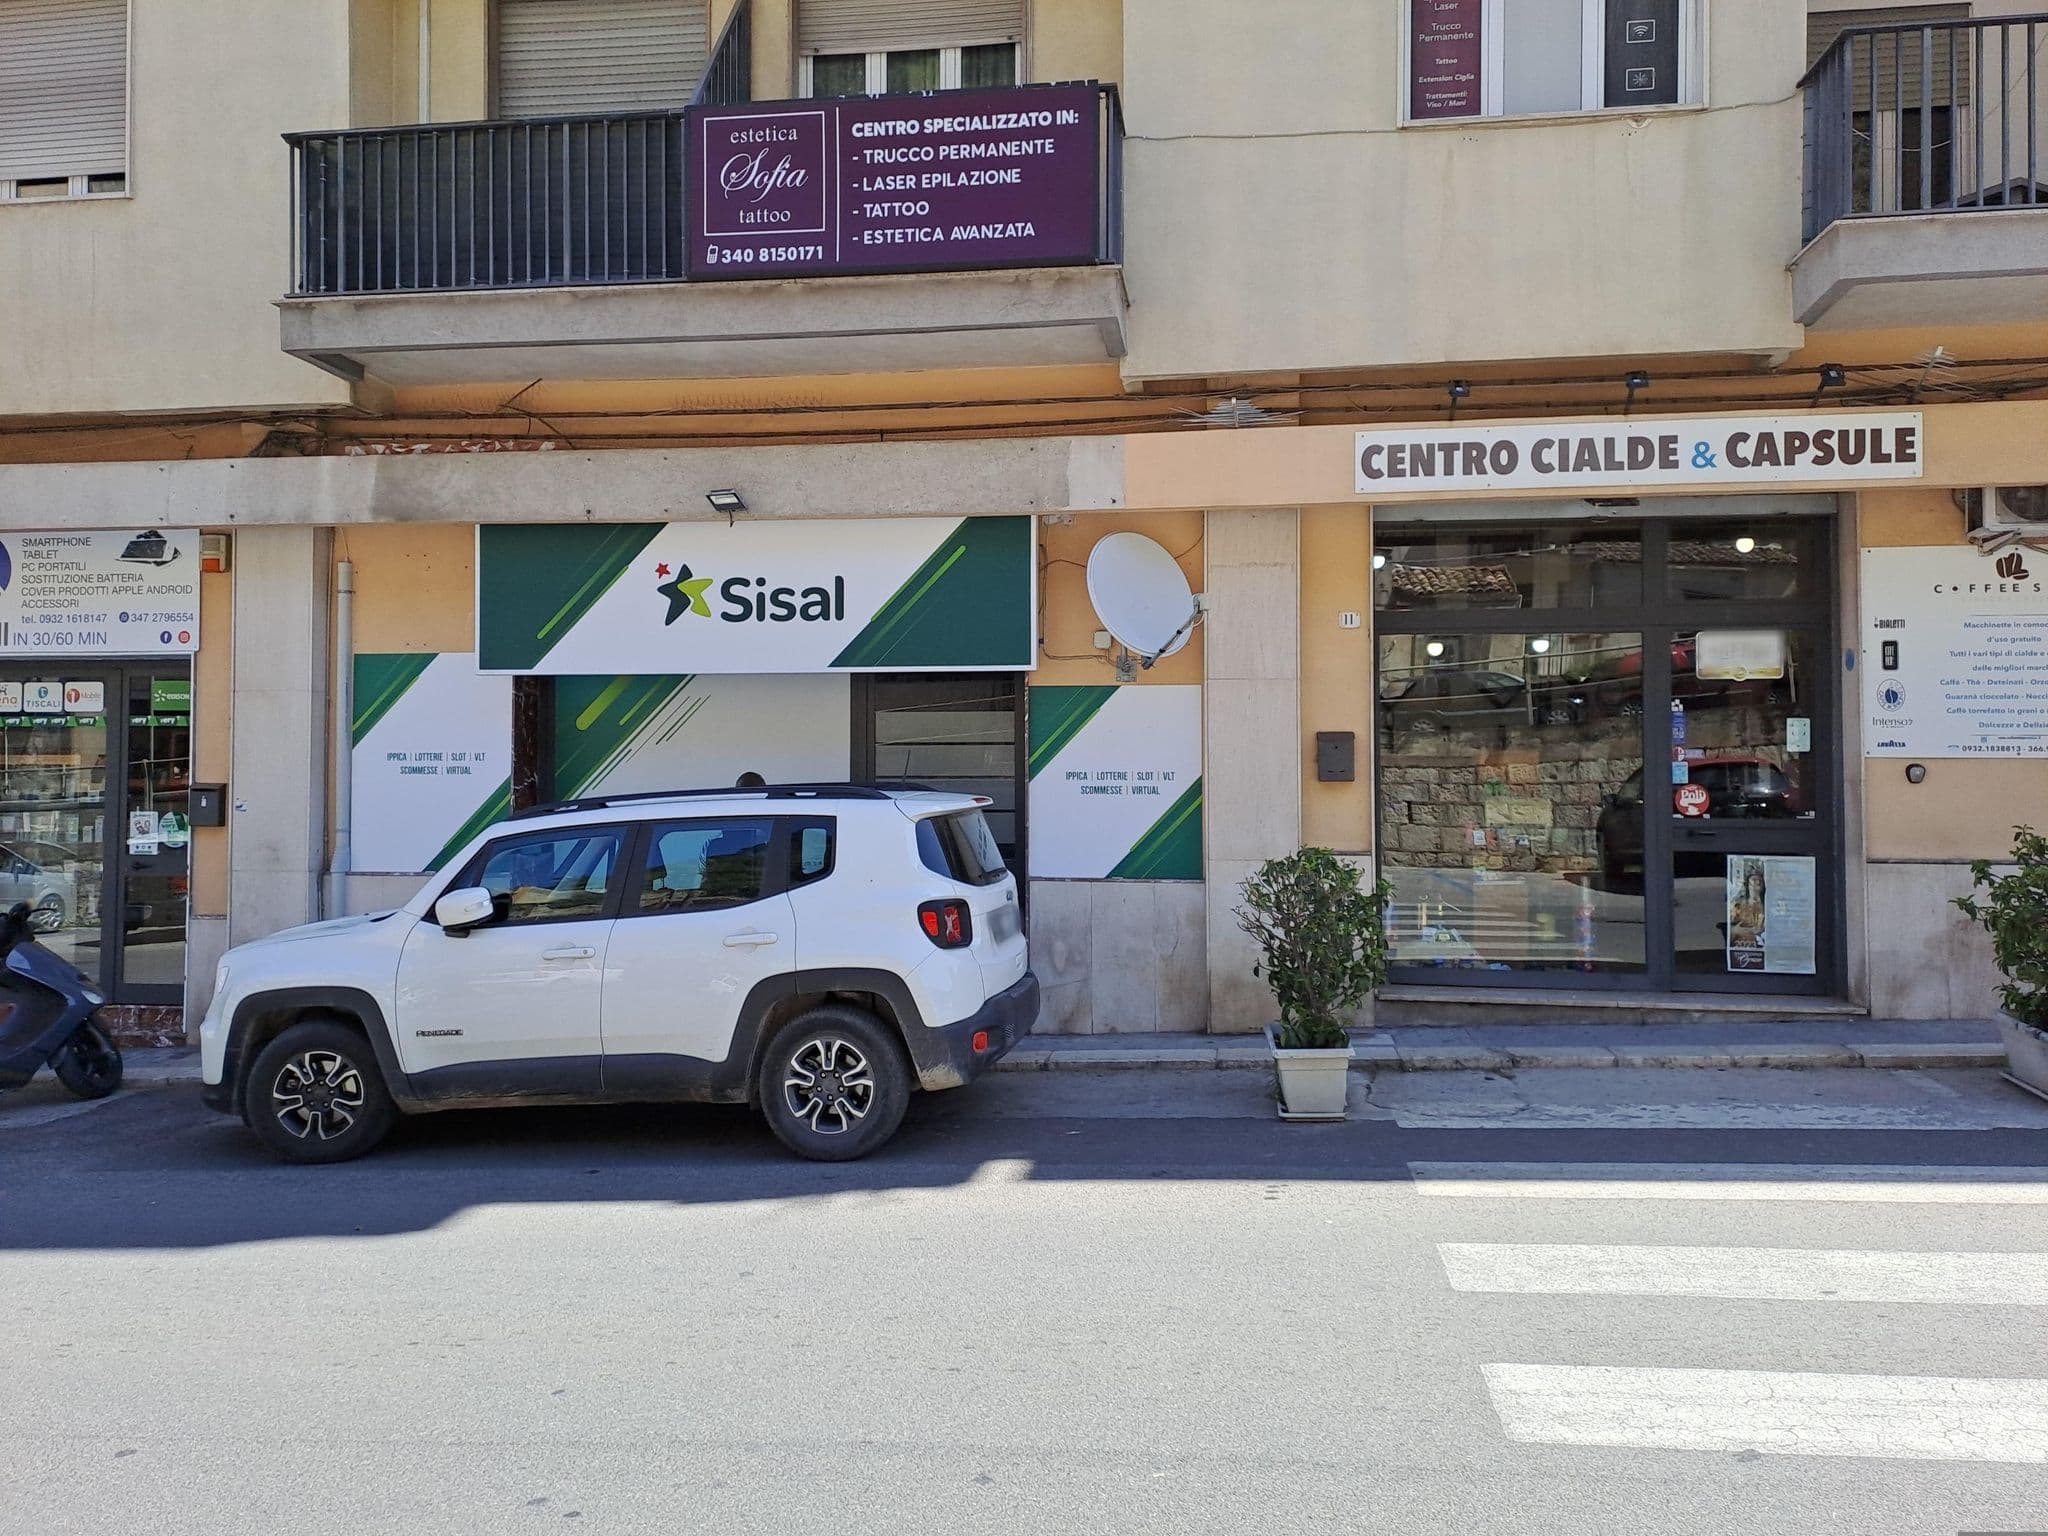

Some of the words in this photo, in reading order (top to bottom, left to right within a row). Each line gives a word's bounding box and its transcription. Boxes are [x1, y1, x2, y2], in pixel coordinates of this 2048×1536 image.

[1434, 3, 1458, 11] Laser
[1432, 23, 1461, 31] Trucco
[1419, 32, 1474, 42] Permanente
[1418, 75, 1453, 83] Extension
[1454, 73, 1475, 82] Ciglia
[852, 119, 920, 138] CENTRO
[923, 111, 1052, 134] SPECIALIZZATO
[1056, 109, 1079, 125] IN:
[730, 126, 797, 144] estetica
[864, 147, 934, 164] TRUCCO
[939, 139, 1055, 159] PERMANENTE
[719, 148, 809, 203] Sofia
[864, 175, 916, 191] LASER
[922, 169, 1021, 188] EPILAZIONE
[864, 201, 930, 218] TATTOO
[738, 207, 791, 224] tattoo
[864, 226, 944, 245] ESTETICA
[950, 222, 1035, 241] AVANZATA
[721, 248, 753, 263] 340
[759, 246, 823, 261] 8150171
[1361, 439, 1520, 480] CENTRO
[1530, 434, 1679, 475] CIALDE
[1691, 441, 1718, 469] &
[1725, 427, 1917, 469] CAPSULE
[22, 537, 92, 547] SMARTPHONE
[23, 550, 59, 559] TABLET
[21, 563, 36, 571] PC
[38, 562, 86, 571] PORTATILI
[21, 574, 94, 584] SOSTITUZIONE
[97, 573, 144, 583] BATTERIA
[21, 587, 56, 596] COVER
[59, 586, 109, 595] PRODOTTI
[112, 586, 143, 595] APPLE
[146, 585, 193, 594] ANDROID
[21, 599, 79, 609] ACCESSORI
[720, 575, 845, 623] Sisal
[22, 615, 36, 624] tel.
[40, 614, 63, 624] 0932
[66, 614, 107, 623] 1618147
[131, 613, 149, 622] 347
[152, 613, 194, 622] 2796554
[1344, 614, 1353, 625] 11
[13, 632, 28, 646] IN
[33, 632, 73, 646] 30/60
[79, 632, 107, 645] MIN
[2010, 636, 2042, 644] gratuito
[1989, 650, 2003, 658] tipi
[387, 753, 407, 761] IPPICA
[415, 753, 443, 761] LOTTERIE
[451, 753, 467, 761] SLOT
[474, 753, 486, 761] VLT
[400, 766, 438, 775] SCOMMESSE
[446, 766, 472, 775] VIRTUAL
[1066, 772, 1088, 780] IPPICA
[1097, 772, 1128, 780] LOTTERIE
[1137, 772, 1153, 780] SLOT
[1163, 772, 1175, 780] VLT
[1080, 786, 1122, 795] SCOMMESSE
[1131, 786, 1160, 795] VIRTUAL
[416, 1029, 463, 1037] RENEGADE
